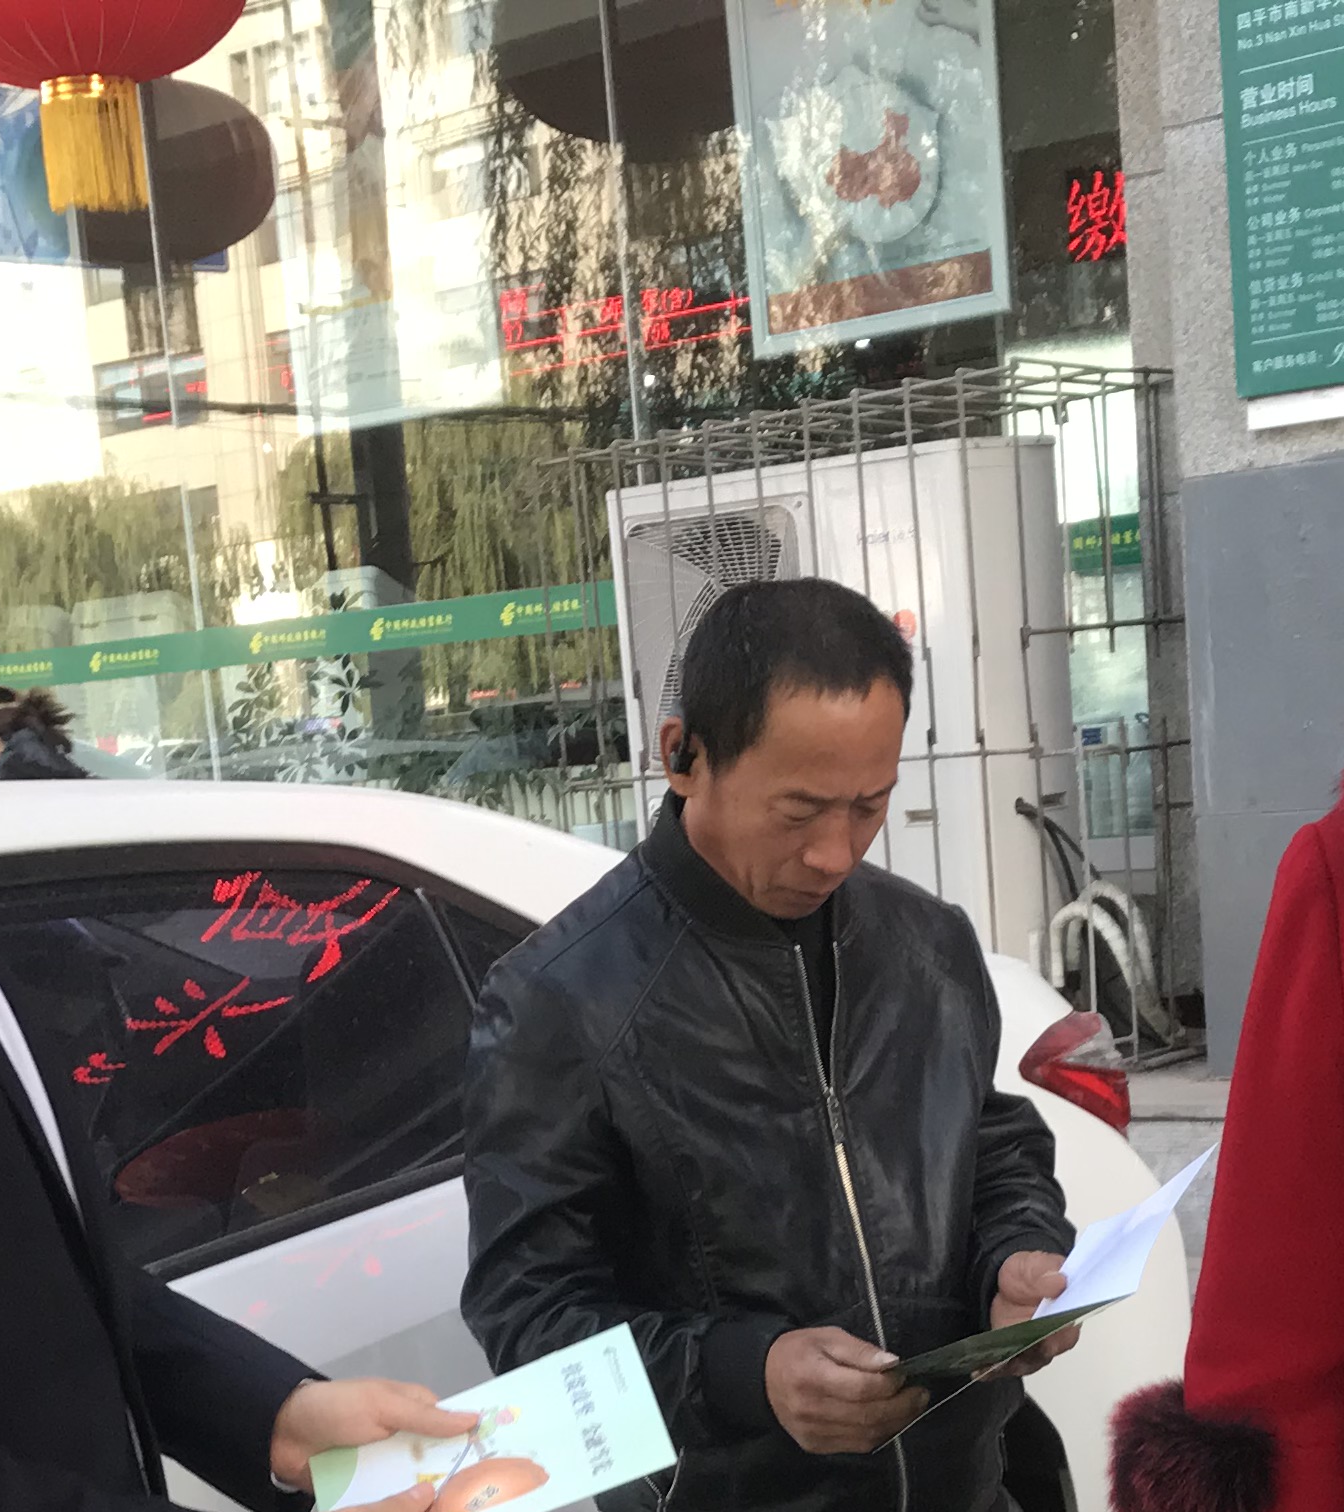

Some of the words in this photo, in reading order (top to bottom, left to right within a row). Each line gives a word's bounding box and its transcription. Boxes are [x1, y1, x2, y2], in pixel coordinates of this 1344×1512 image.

[1265, 29, 1287, 43] Nan
[1309, 18, 1331, 33] Hua
[1240, 73, 1315, 110] 营业时间
[1241, 106, 1296, 129] Business
[1299, 96, 1337, 115] Hours
[1243, 142, 1297, 167] 个人业务
[1246, 206, 1301, 231] 公司业务
